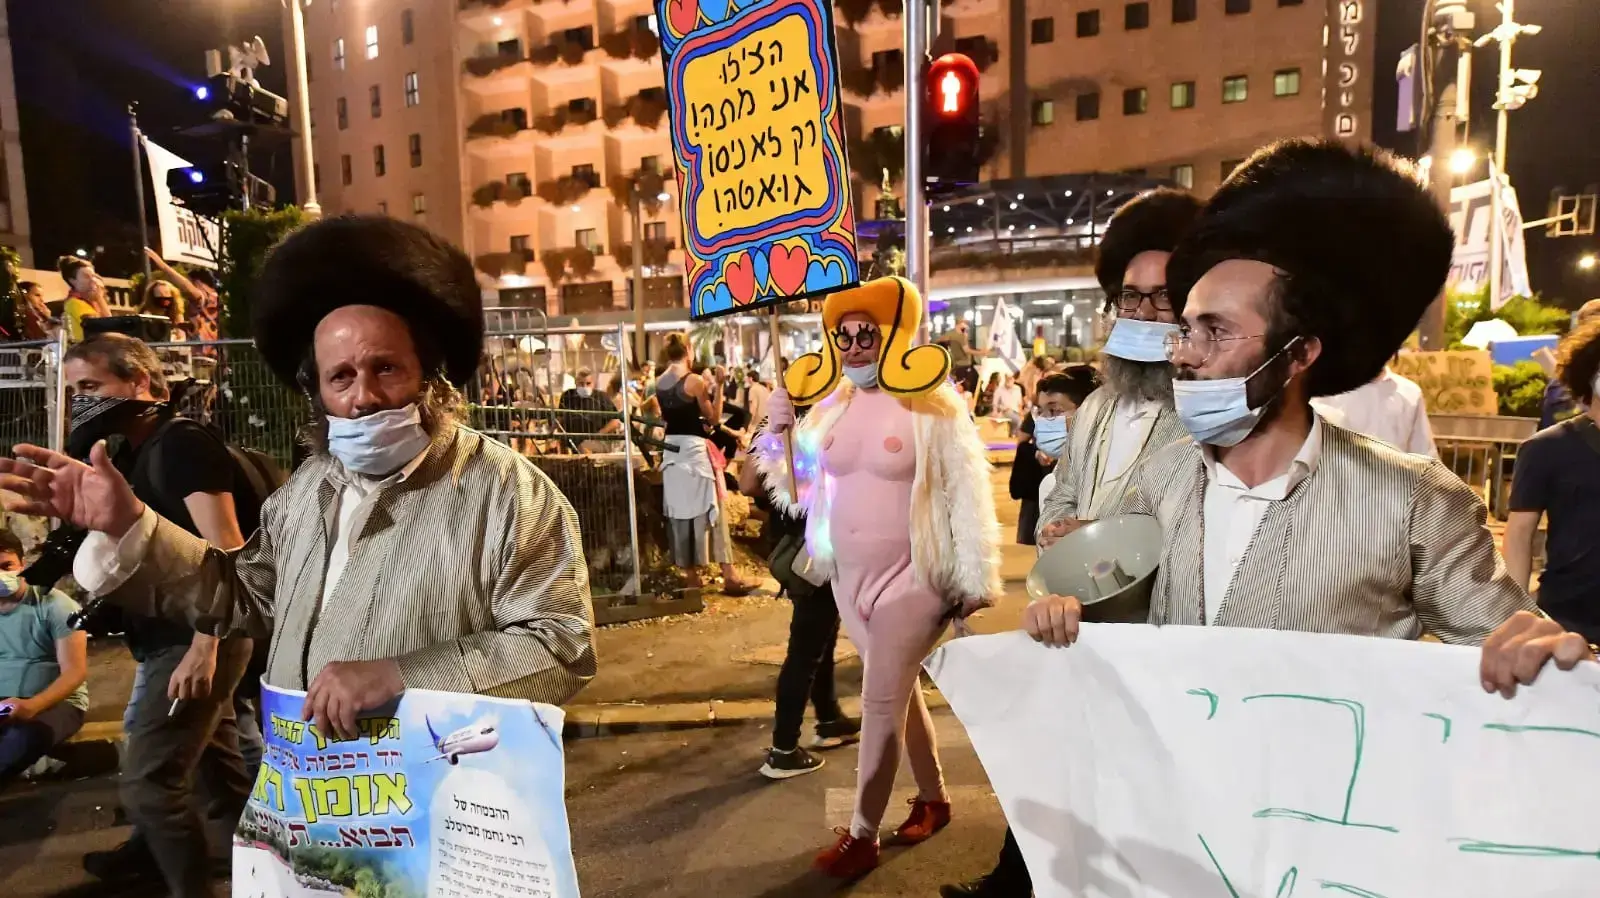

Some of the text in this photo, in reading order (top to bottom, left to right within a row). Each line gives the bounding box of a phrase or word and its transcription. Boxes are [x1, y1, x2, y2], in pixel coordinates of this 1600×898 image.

[691, 69, 809, 137] אני מתה!
[791, 120, 816, 166] רק
[306, 752, 370, 772] רבבות
[294, 772, 413, 823] אומן
[453, 793, 510, 821] ההבטחה של
[319, 825, 415, 848] תבוא...
[444, 815, 525, 848] רבי נחמן מברסלב
